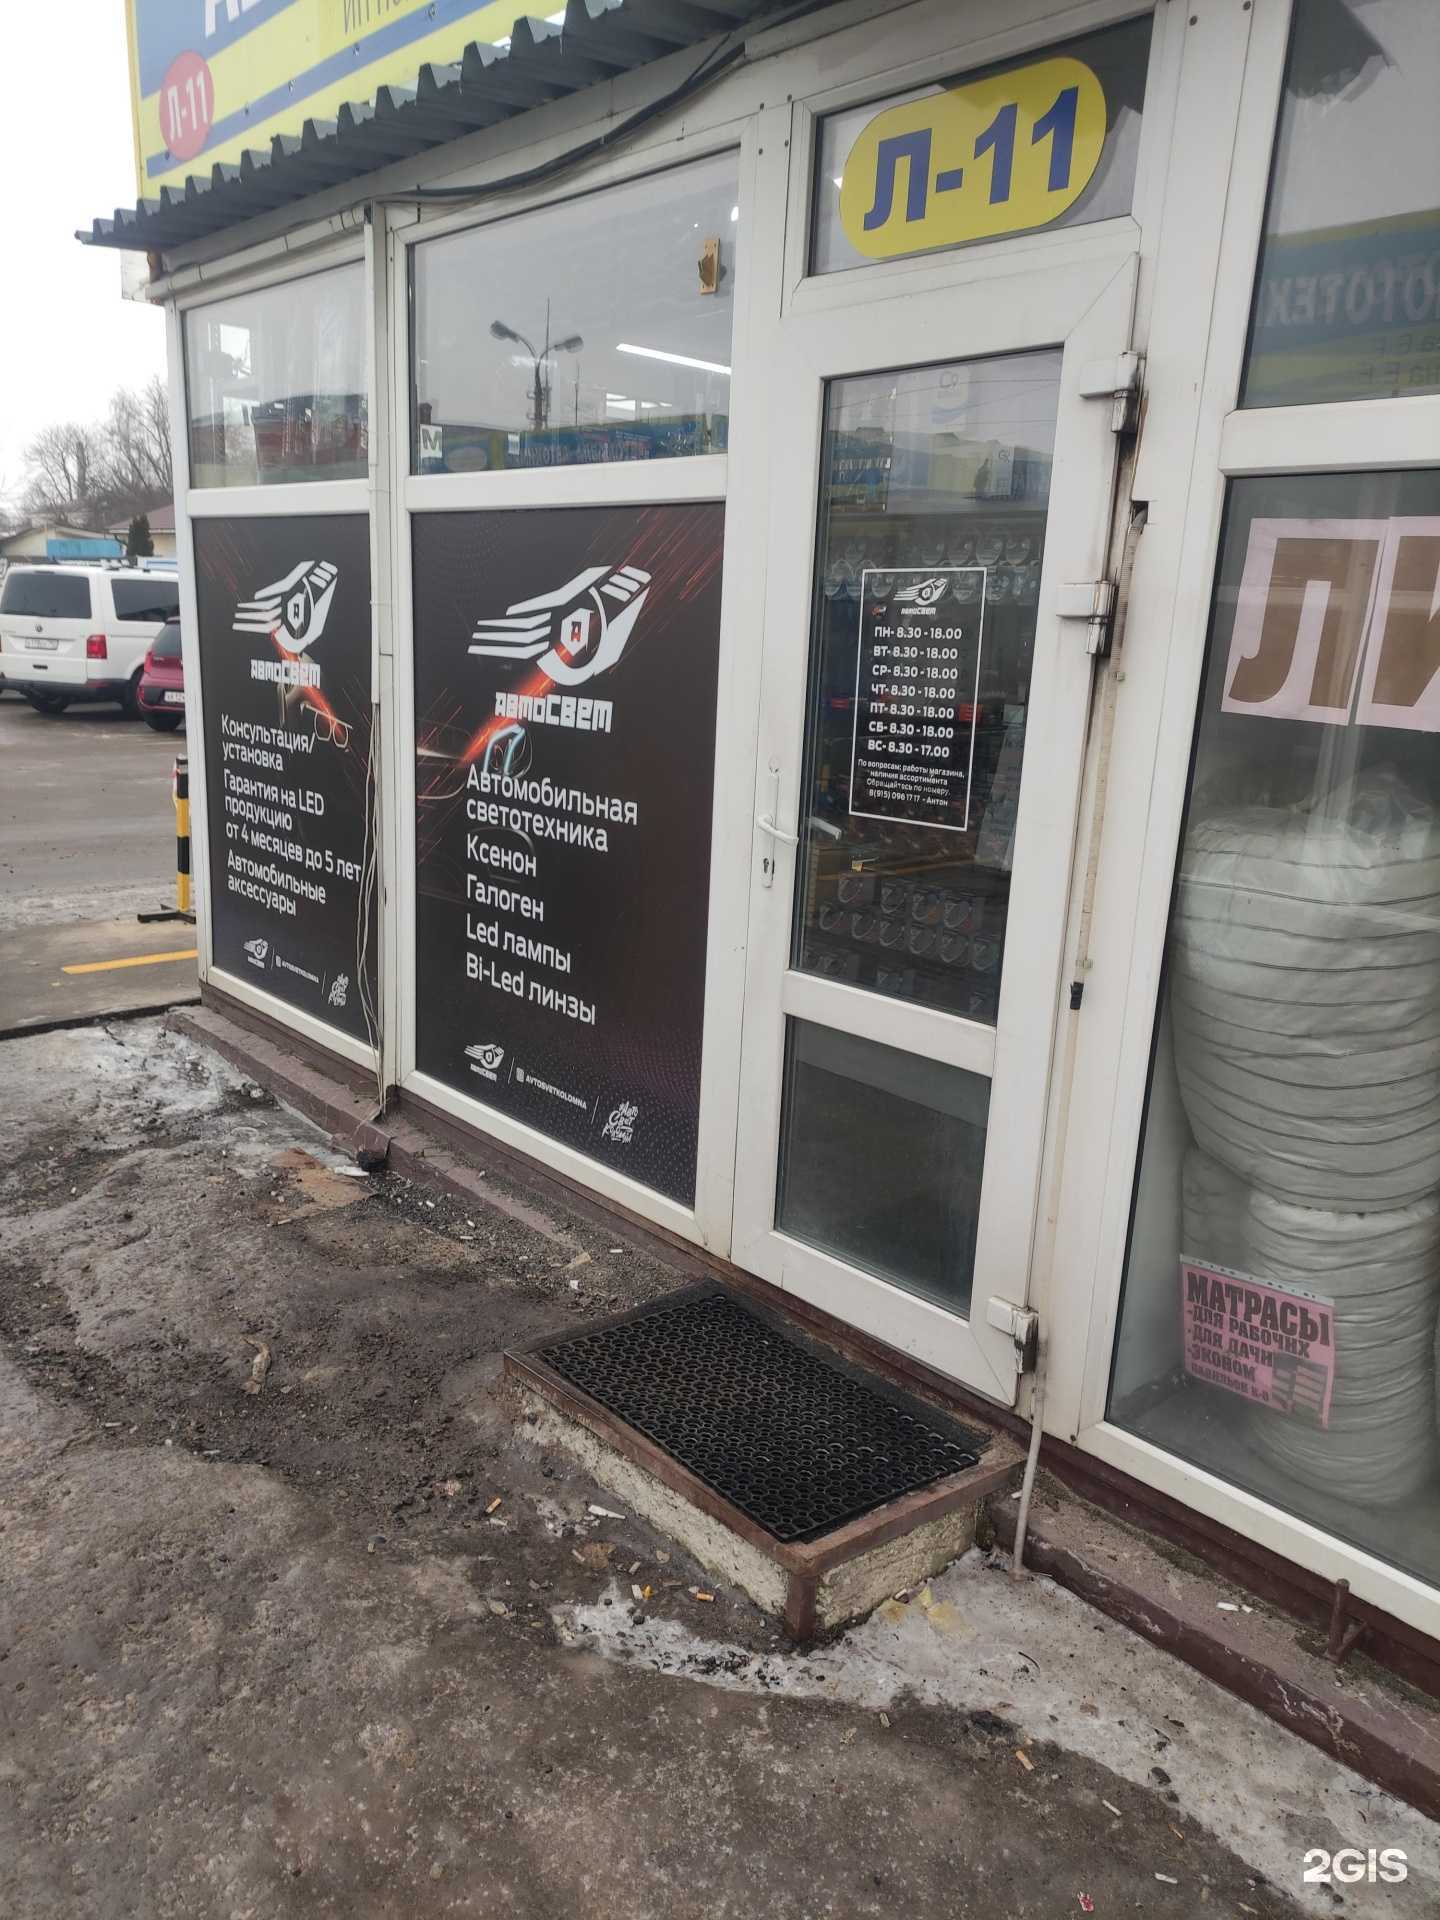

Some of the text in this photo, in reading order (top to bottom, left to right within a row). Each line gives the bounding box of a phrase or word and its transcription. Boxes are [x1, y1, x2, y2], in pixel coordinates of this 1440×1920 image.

[166, 71, 209, 142] Л-11
[863, 86, 1079, 231] Л-11
[893, 646, 918, 658] 8.30
[926, 648, 958, 660] 18.00
[896, 626, 922, 638] 8.30
[930, 628, 962, 640] 18.00
[890, 684, 916, 696] 8.30
[924, 686, 956, 699] 18.00
[893, 666, 918, 678] 8.30
[926, 667, 958, 680] 18.00
[890, 704, 914, 716] 8.30
[923, 706, 954, 719] 18.00
[890, 722, 914, 735] 8.30
[922, 726, 954, 738] 18.00
[221, 713, 316, 754] Консультация/
[888, 741, 912, 754] 8.30
[921, 744, 950, 758] 17.00
[222, 740, 284, 771] установка
[902, 764, 928, 774] работы
[224, 769, 325, 816] Гарантия на LED
[466, 763, 638, 825] Автомобильная
[866, 778, 913, 790] Обращайтесь
[869, 789, 891, 799] 8(915)
[926, 796, 948, 806] Антон
[870, 770, 948, 785] наличия ассортимента
[225, 796, 292, 831] продукцию
[466, 798, 609, 852] светотехника
[226, 821, 361, 883] от 4 месяцев до 5 лет
[467, 833, 537, 877] Ксенон
[228, 848, 326, 904] Автомобильные
[228, 873, 297, 916] аксессуары
[467, 873, 544, 922] Галоген
[466, 913, 571, 973] Led лампы
[466, 951, 596, 1025] Bi-Led линзы
[1187, 1271, 1330, 1346] МАТРАСЫ
[1229, 1317, 1310, 1358] РАБОЧИХ
